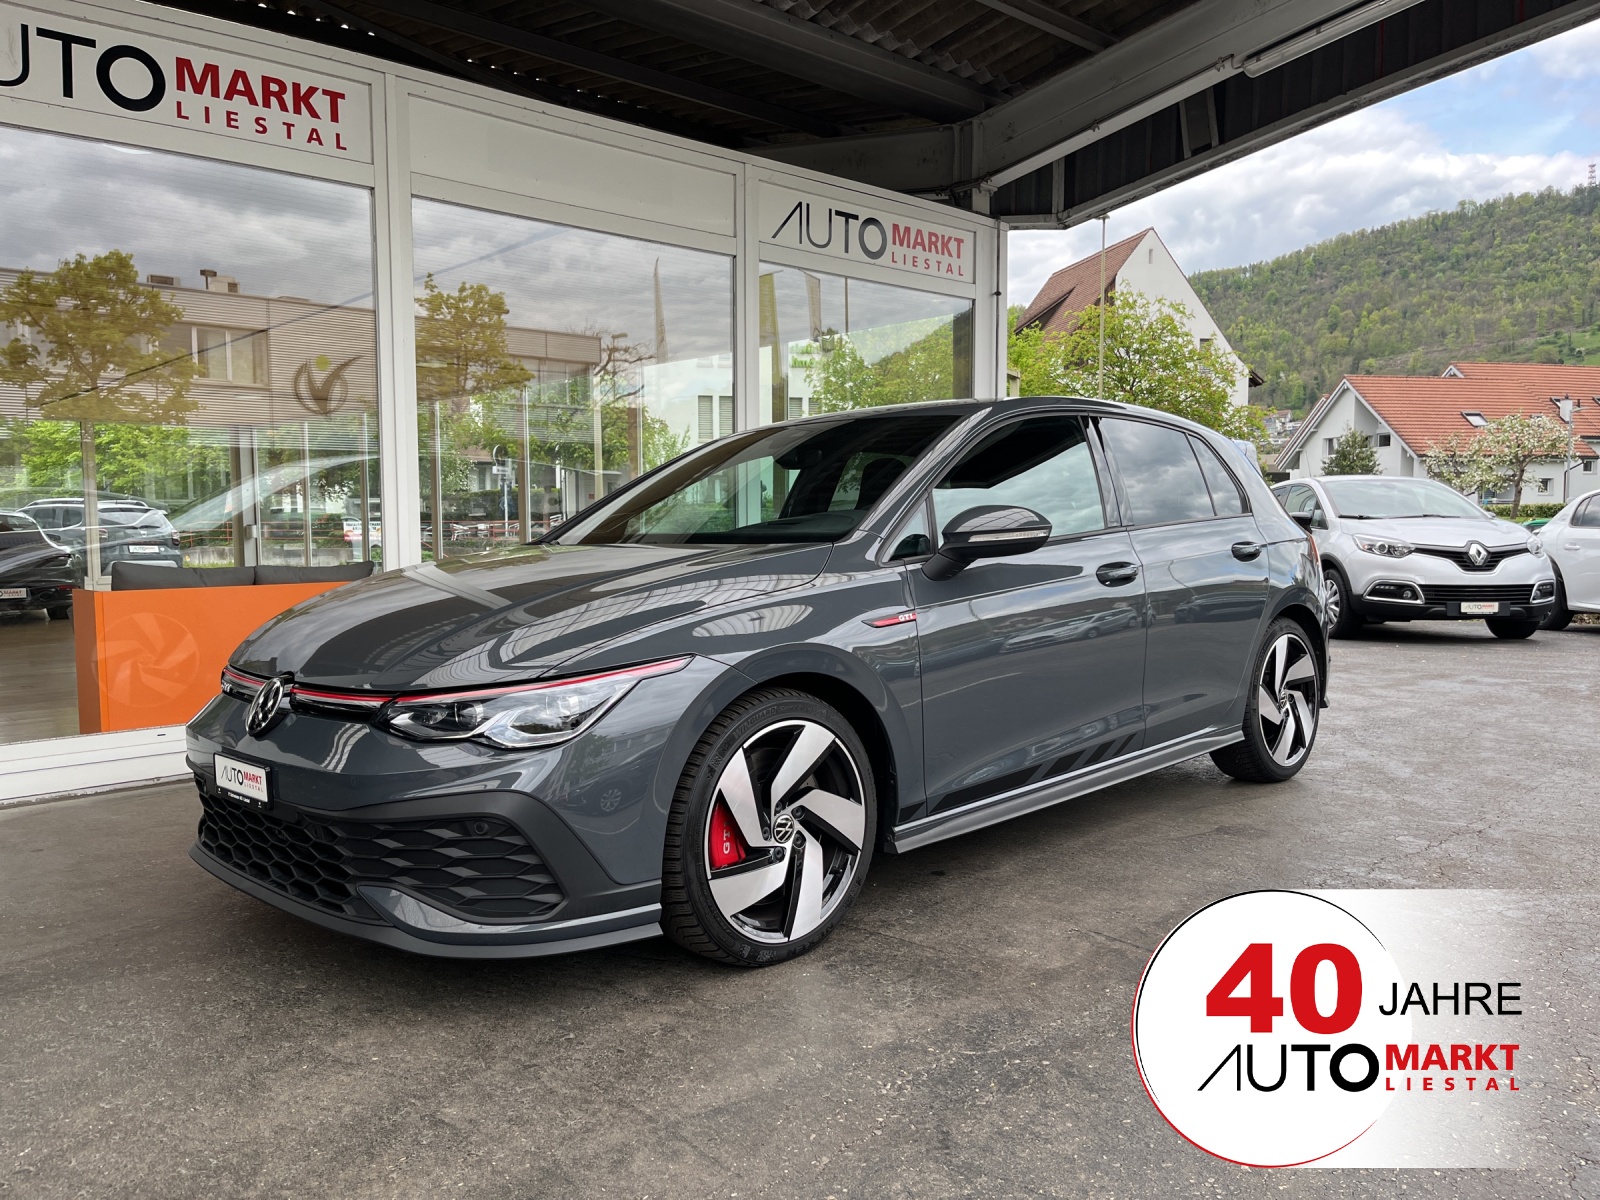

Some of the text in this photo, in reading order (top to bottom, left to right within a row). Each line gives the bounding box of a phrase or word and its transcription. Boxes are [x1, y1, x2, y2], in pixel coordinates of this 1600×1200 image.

[175, 56, 346, 124] MARKT
[176, 101, 347, 151] LIESTAL
[771, 201, 964, 260] AUTO MARKT
[891, 251, 964, 277] LIESTAL
[898, 613, 913, 621] GTI
[221, 766, 262, 785] AUTO MARKT
